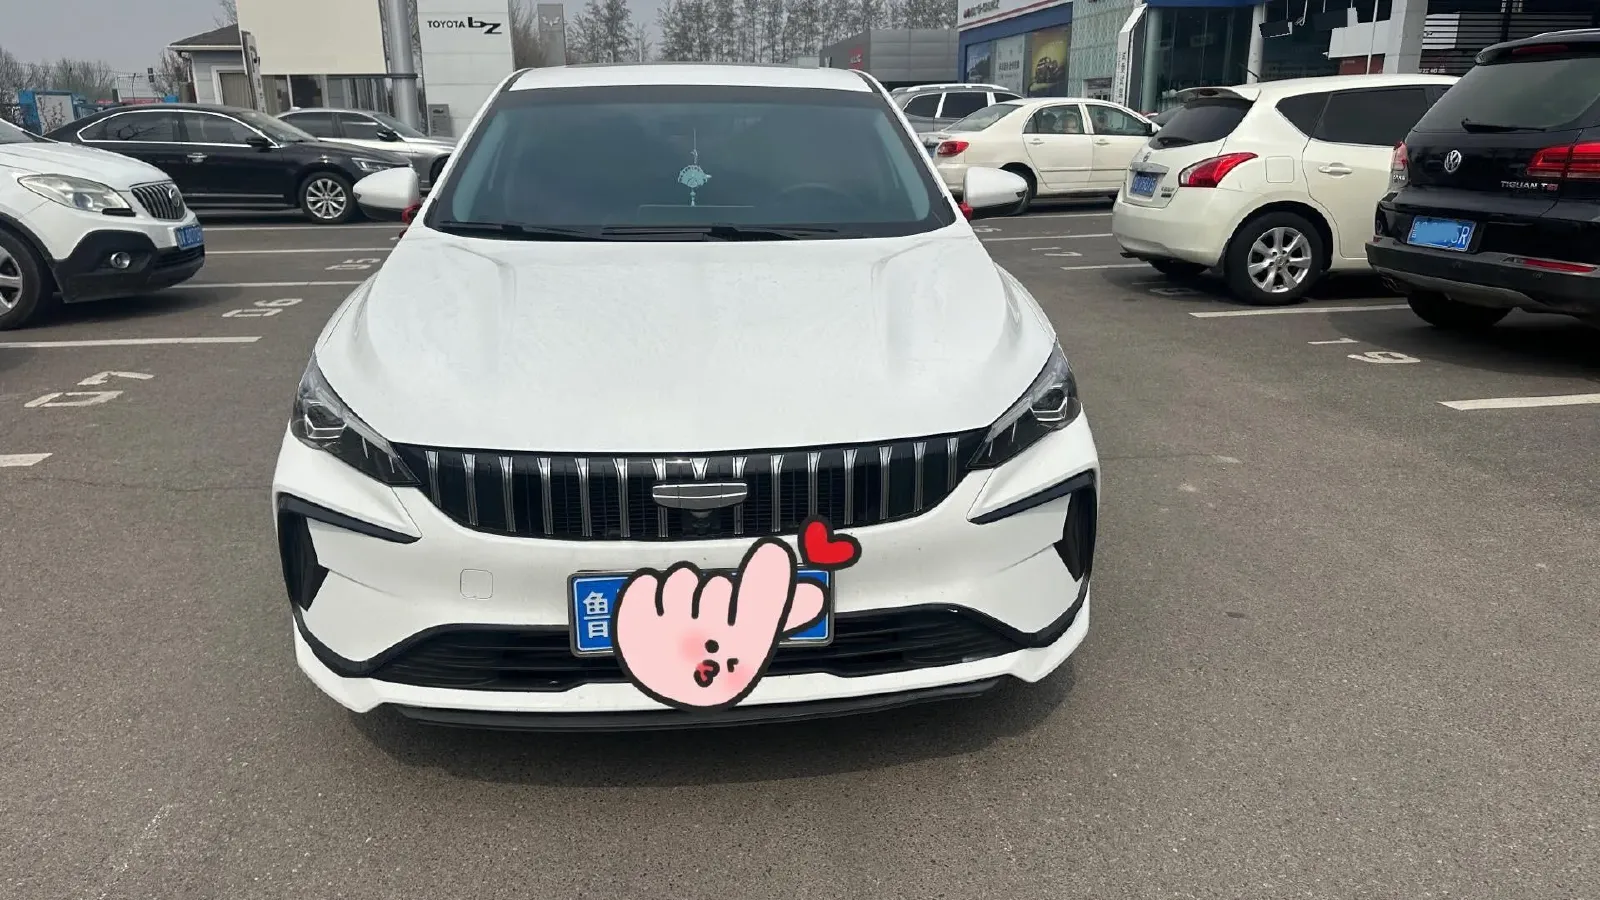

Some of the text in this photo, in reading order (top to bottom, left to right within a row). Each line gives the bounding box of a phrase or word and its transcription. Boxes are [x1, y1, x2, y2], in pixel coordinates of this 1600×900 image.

[427, 20, 466, 28] TOYOTA
[1500, 180, 1538, 190] TIGUAN
[221, 297, 303, 318] 06
[1307, 337, 1421, 364] 19
[24, 370, 154, 408] 07
